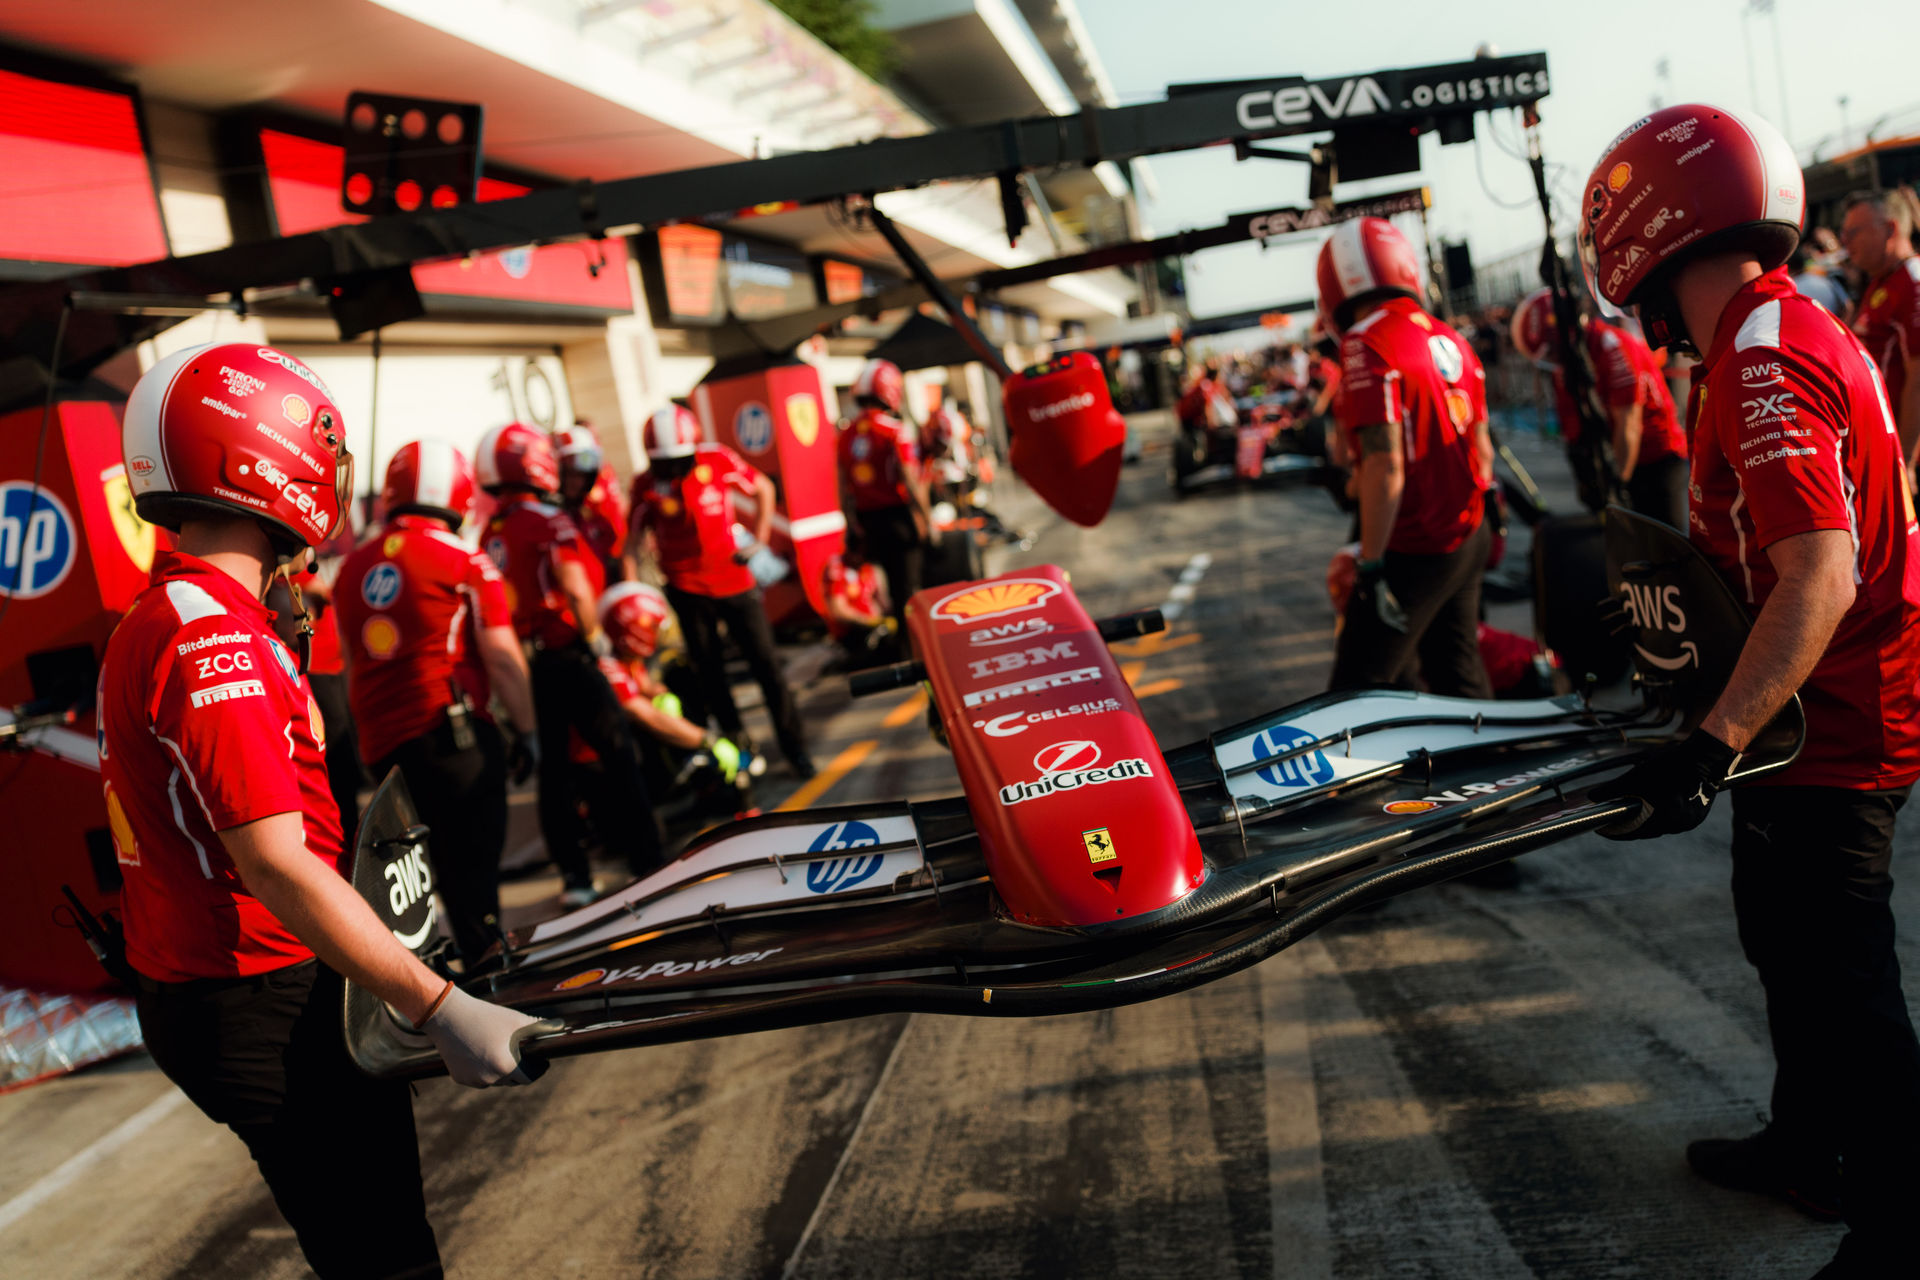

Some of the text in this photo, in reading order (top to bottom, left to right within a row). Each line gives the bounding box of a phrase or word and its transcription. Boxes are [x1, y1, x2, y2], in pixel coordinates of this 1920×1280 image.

[1236, 77, 1391, 130] CEVA
[1656, 117, 1698, 142] PERONI
[1602, 183, 1653, 246] RICHARD MILLE
[219, 365, 267, 392] PERONI
[1741, 362, 1783, 381] aws
[1741, 392, 1797, 423] DXC
[1746, 414, 1798, 430] TECHNOLOGY
[256, 422, 325, 477] RICHARD MILLE
[1740, 428, 1813, 451] RICHARD MILLE
[132, 460, 152, 471] BELL
[1745, 446, 1818, 469] HCLSoftware
[213, 486, 260, 507] TEMELLINI
[283, 483, 330, 533] CEVA
[1620, 581, 1687, 633] aws
[177, 631, 252, 656] Bitdefender
[969, 617, 1048, 642] aws
[195, 651, 253, 679] ZCG
[968, 641, 1079, 679] IBM
[963, 666, 1102, 707] PIRELLI
[1027, 698, 1119, 723] CELSIUS
[1260, 728, 1321, 787] hp
[1001, 758, 1153, 805] UniCredit
[1422, 757, 1587, 802] V-Power
[811, 821, 876, 893] hp
[384, 843, 432, 916] aws
[601, 947, 784, 985] V-Power
